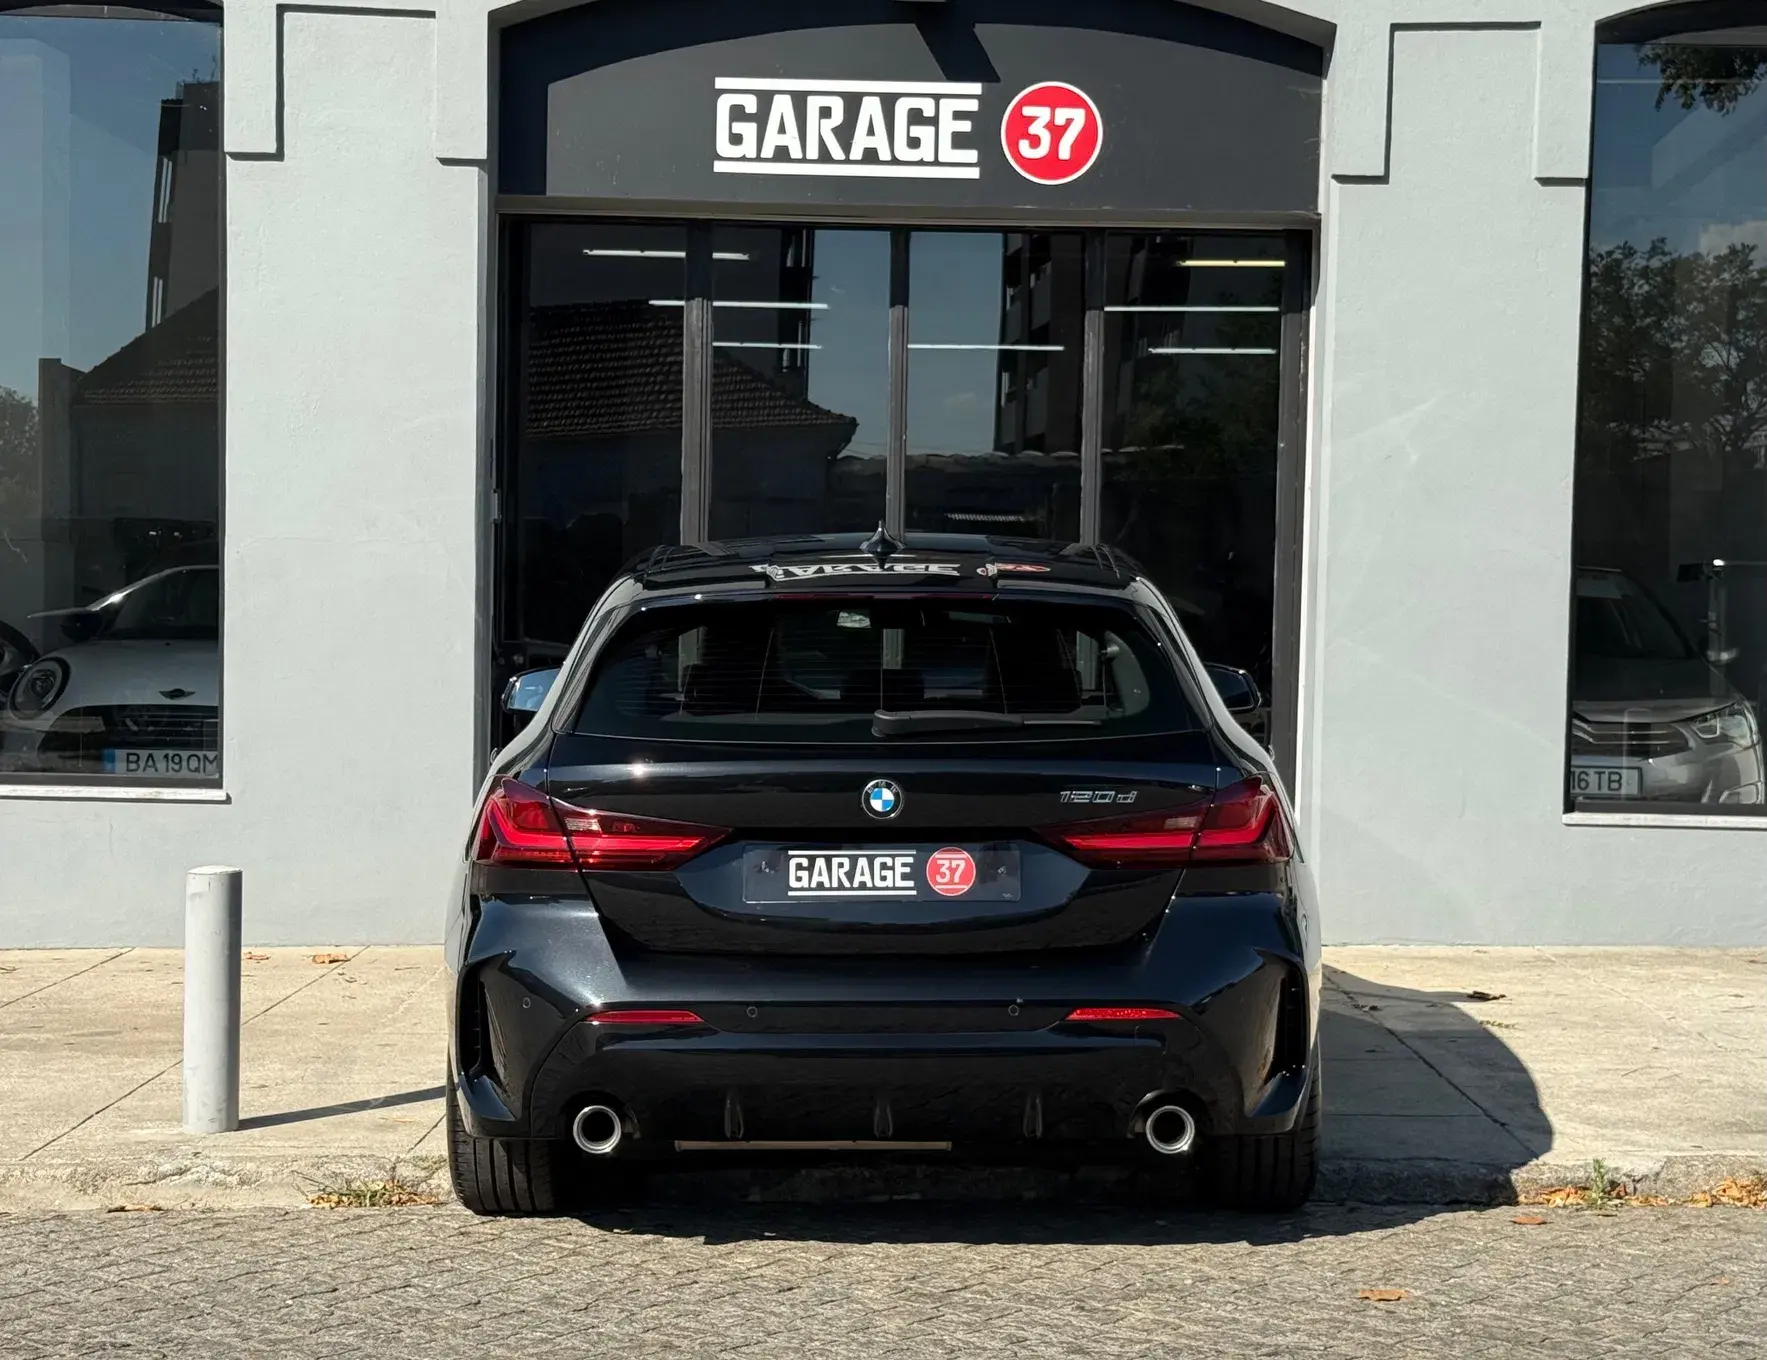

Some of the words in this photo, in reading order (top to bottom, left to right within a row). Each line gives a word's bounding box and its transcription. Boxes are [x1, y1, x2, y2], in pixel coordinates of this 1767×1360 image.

[716, 93, 979, 164] GARAGE
[1018, 105, 1086, 161] 37
[788, 857, 914, 888] GARAGE
[935, 859, 966, 883] 37
